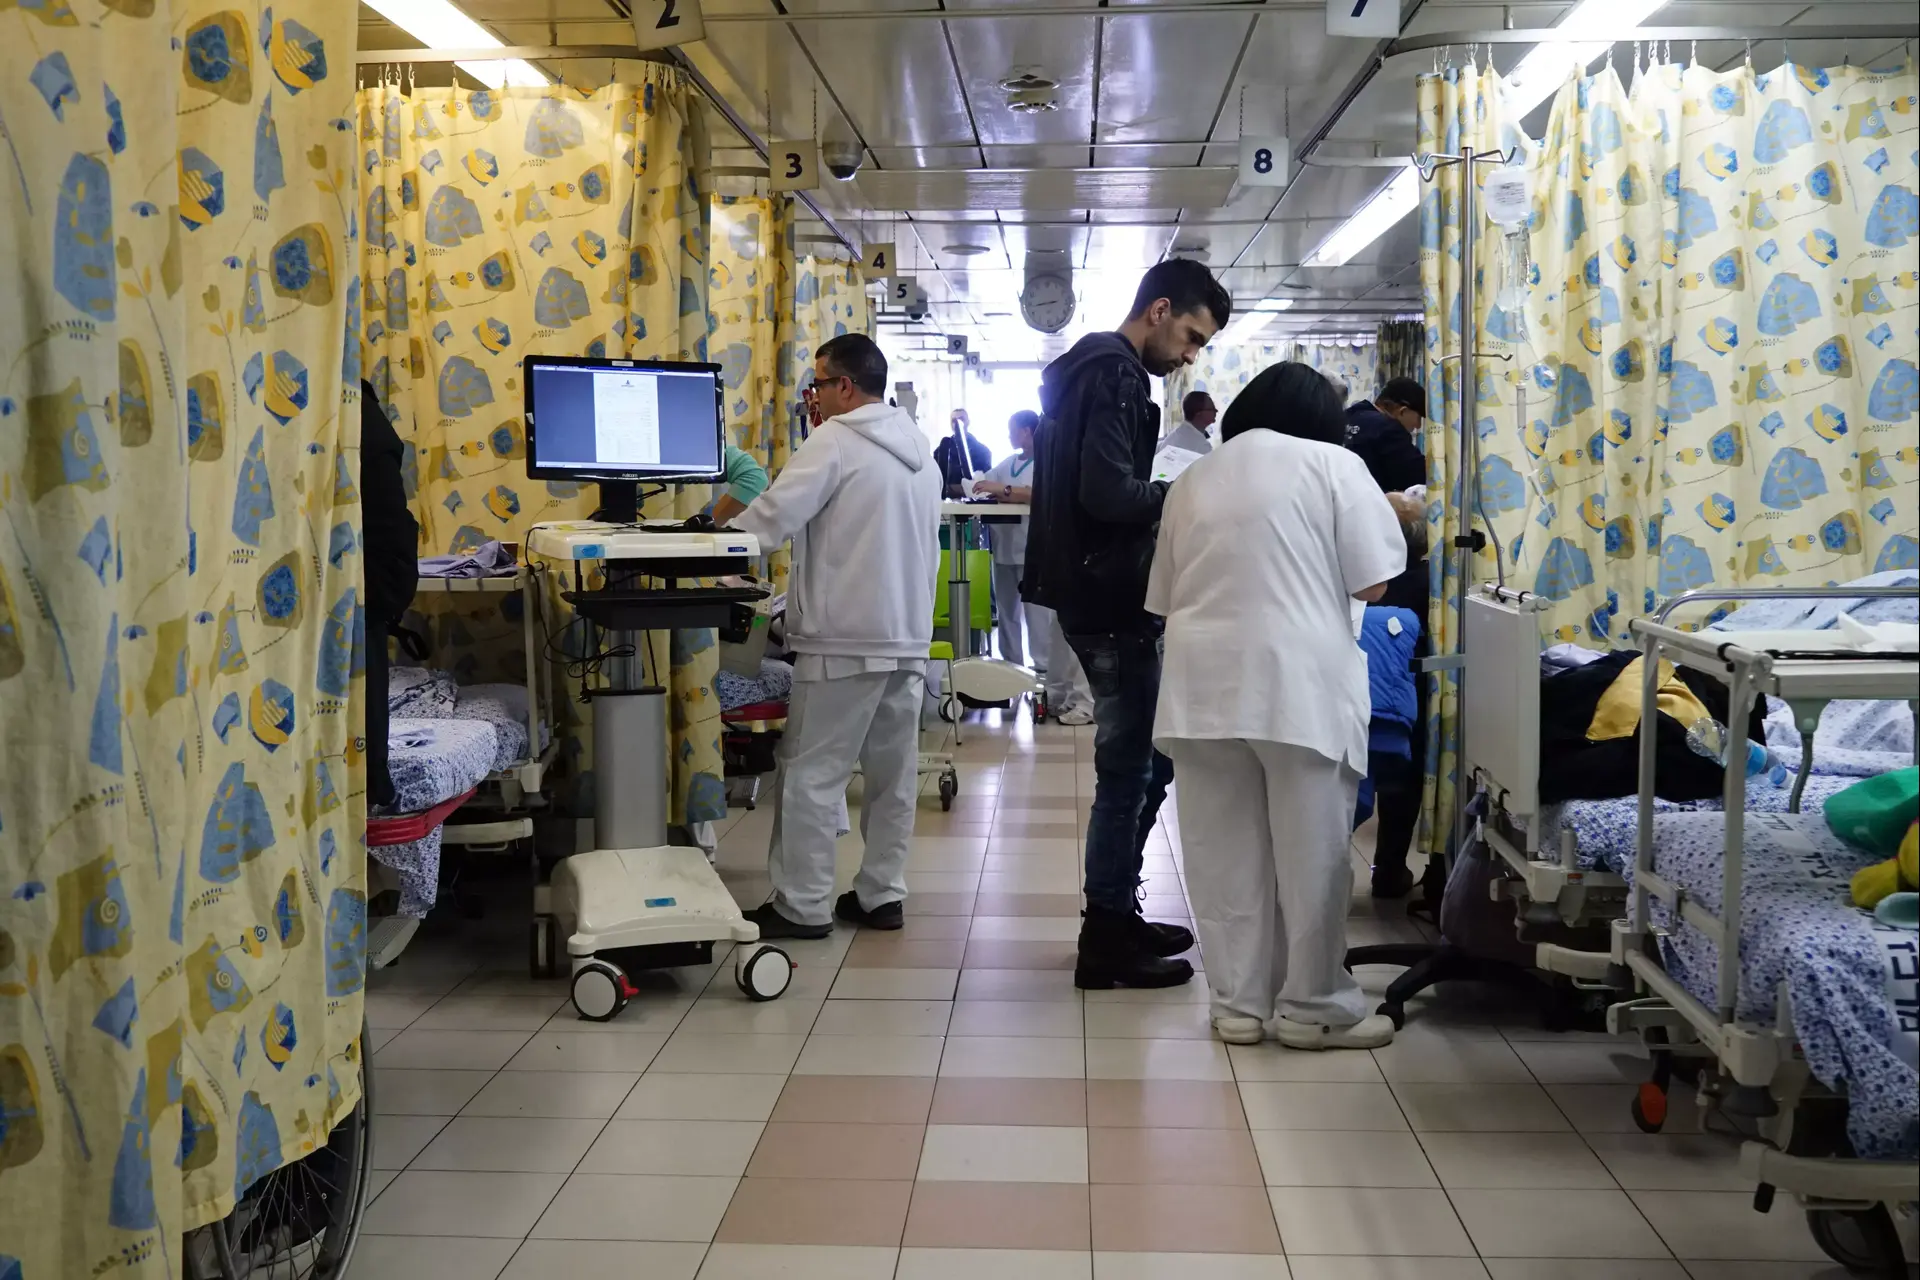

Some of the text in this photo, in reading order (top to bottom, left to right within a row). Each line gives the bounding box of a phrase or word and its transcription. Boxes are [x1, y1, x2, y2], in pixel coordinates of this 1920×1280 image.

[654, 0, 681, 29] 2
[785, 153, 803, 178] 3
[1254, 148, 1273, 174] 8
[873, 252, 886, 269] 4
[896, 284, 907, 299] 5
[953, 339, 962, 350] 9
[965, 356, 978, 366] 10
